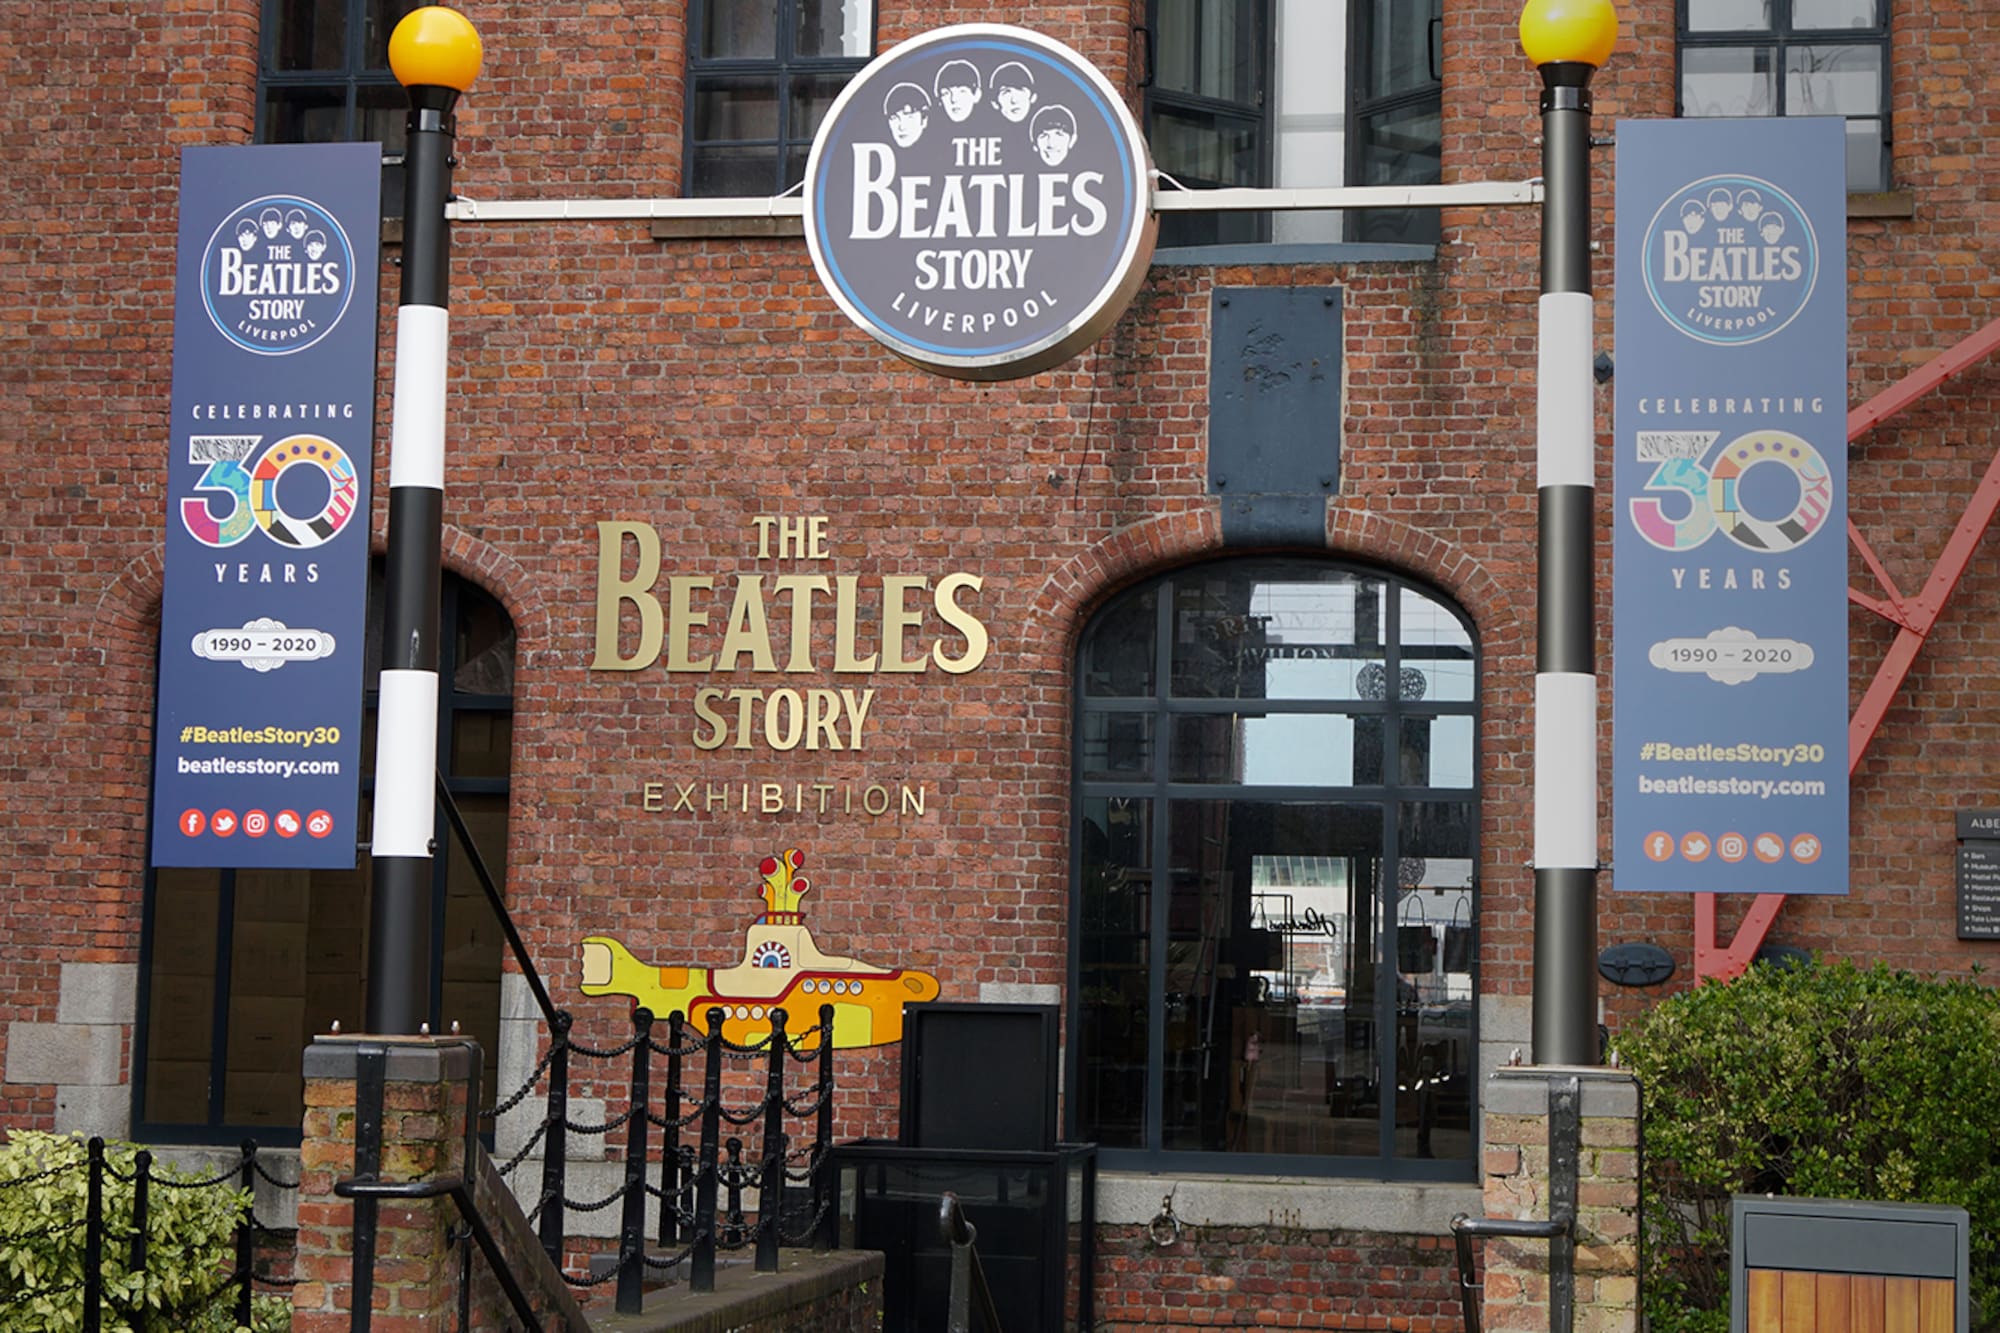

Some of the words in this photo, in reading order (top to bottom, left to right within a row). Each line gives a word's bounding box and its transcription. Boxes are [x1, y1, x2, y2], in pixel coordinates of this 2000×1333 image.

[951, 137, 1003, 167] THE
[849, 142, 1108, 239] BEATLES
[1716, 227, 1745, 245] THE
[267, 245, 292, 261] THE
[1663, 230, 1802, 282] BEATLES
[218, 247, 340, 296] BEATLES
[914, 248, 1034, 291] STORY
[1698, 285, 1763, 309] STORY
[248, 299, 305, 320] STORY
[891, 290, 1058, 334] LIVERPOOL
[1686, 307, 1777, 331] LIVERPOOL
[237, 318, 317, 341] LIVERPOOL
[192, 403, 353, 420] CELEBRATING
[1638, 397, 1823, 415] CELEBRATING
[180, 433, 359, 549] 30
[1628, 429, 1833, 554] 30
[751, 515, 830, 560] THE
[214, 563, 320, 583] YEARS
[1671, 568, 1792, 590] YEARS
[590, 520, 989, 674] BEATLES
[210, 637, 252, 652] 1990
[272, 637, 317, 652] 2020
[1671, 648, 1718, 663] 1990
[1742, 648, 1792, 663] 2020
[692, 687, 877, 752] STORY
[180, 726, 341, 748] #BeatlesStory30
[1639, 742, 1825, 767] #BeatlesStory30
[177, 756, 340, 779] beatlesstory.com
[1638, 774, 1825, 799] beatlesstory.com
[643, 782, 926, 817] EXHIBITION
